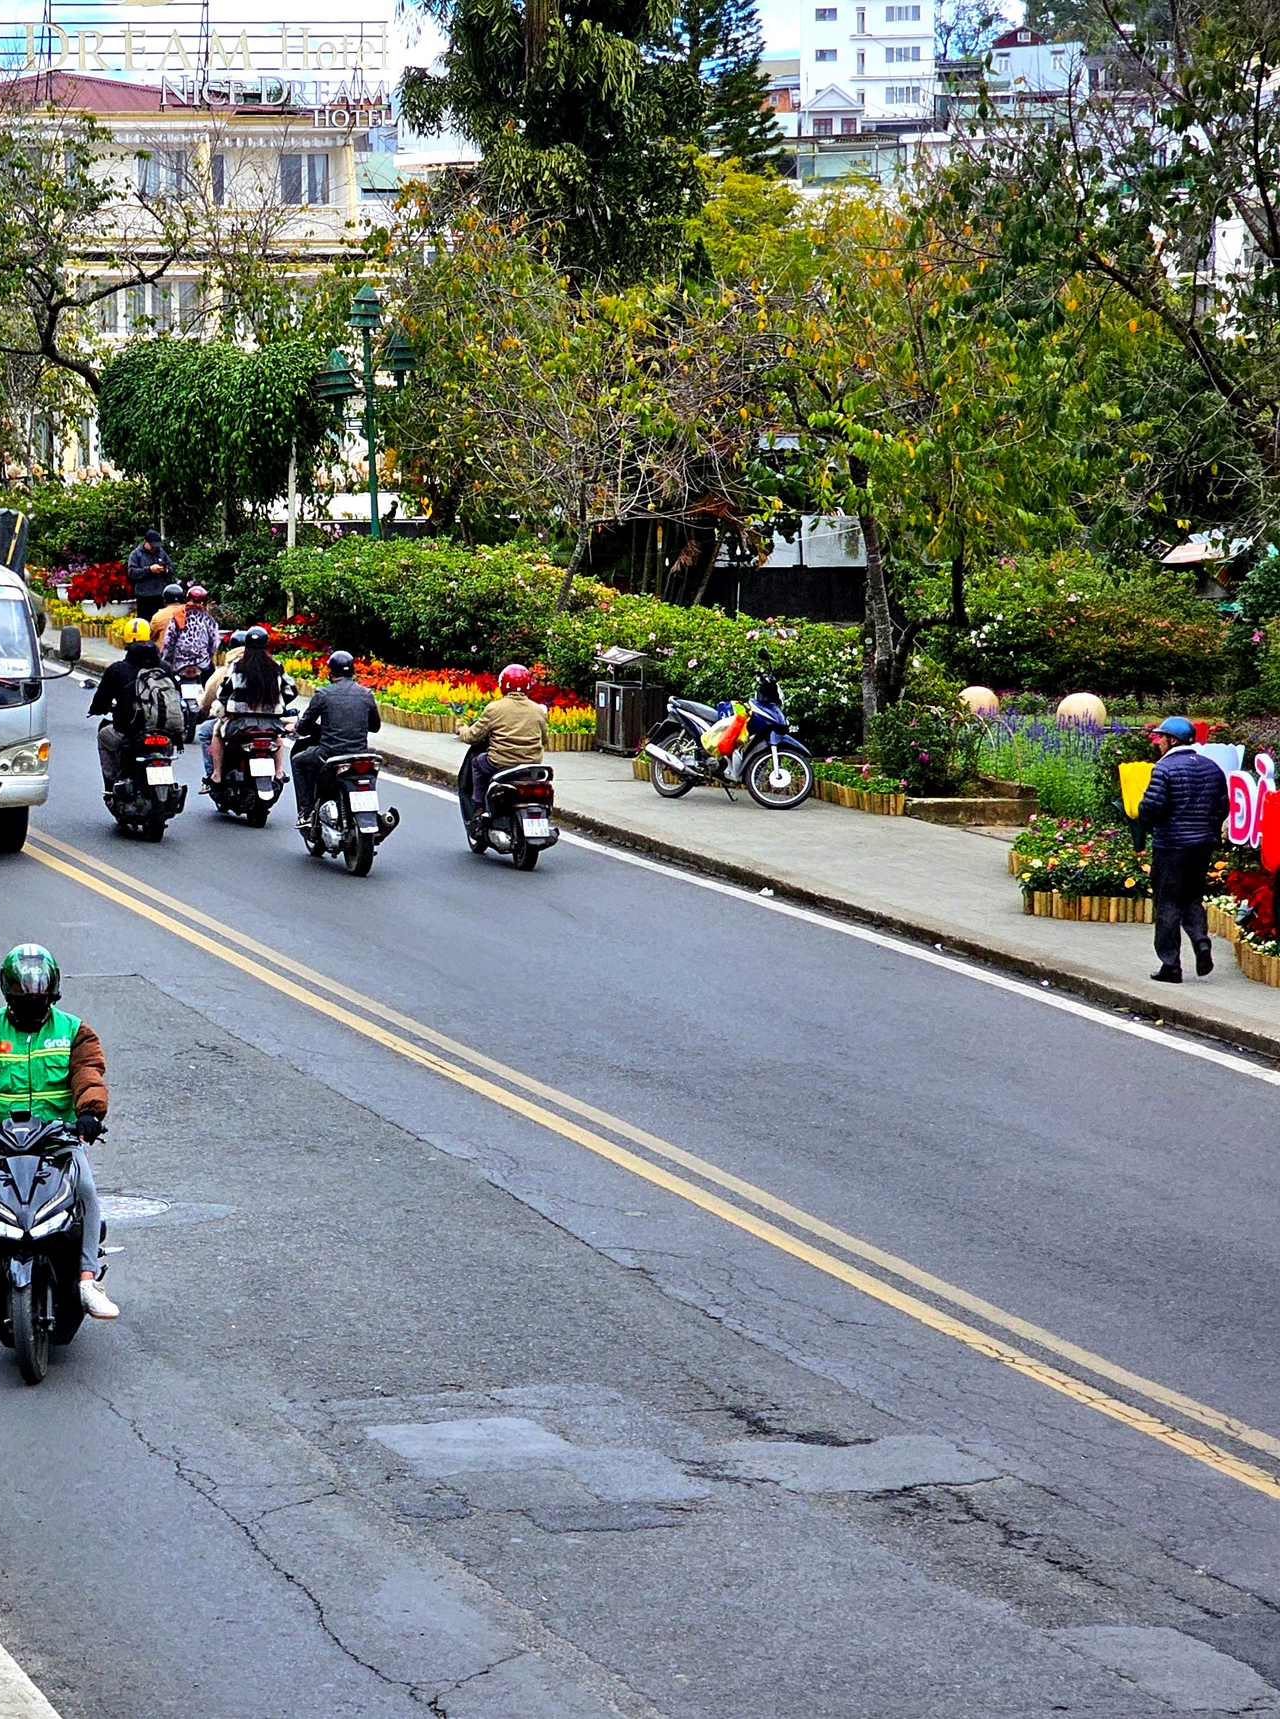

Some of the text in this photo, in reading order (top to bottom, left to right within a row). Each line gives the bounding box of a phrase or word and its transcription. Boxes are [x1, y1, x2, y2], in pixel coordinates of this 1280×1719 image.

[22, 23, 253, 72] DREAM
[279, 24, 389, 71] Hotel
[160, 74, 390, 106] NICE DREAM
[313, 109, 391, 128] HOTEL
[21, 965, 43, 975] Grab
[44, 1037, 71, 1048] Grab
